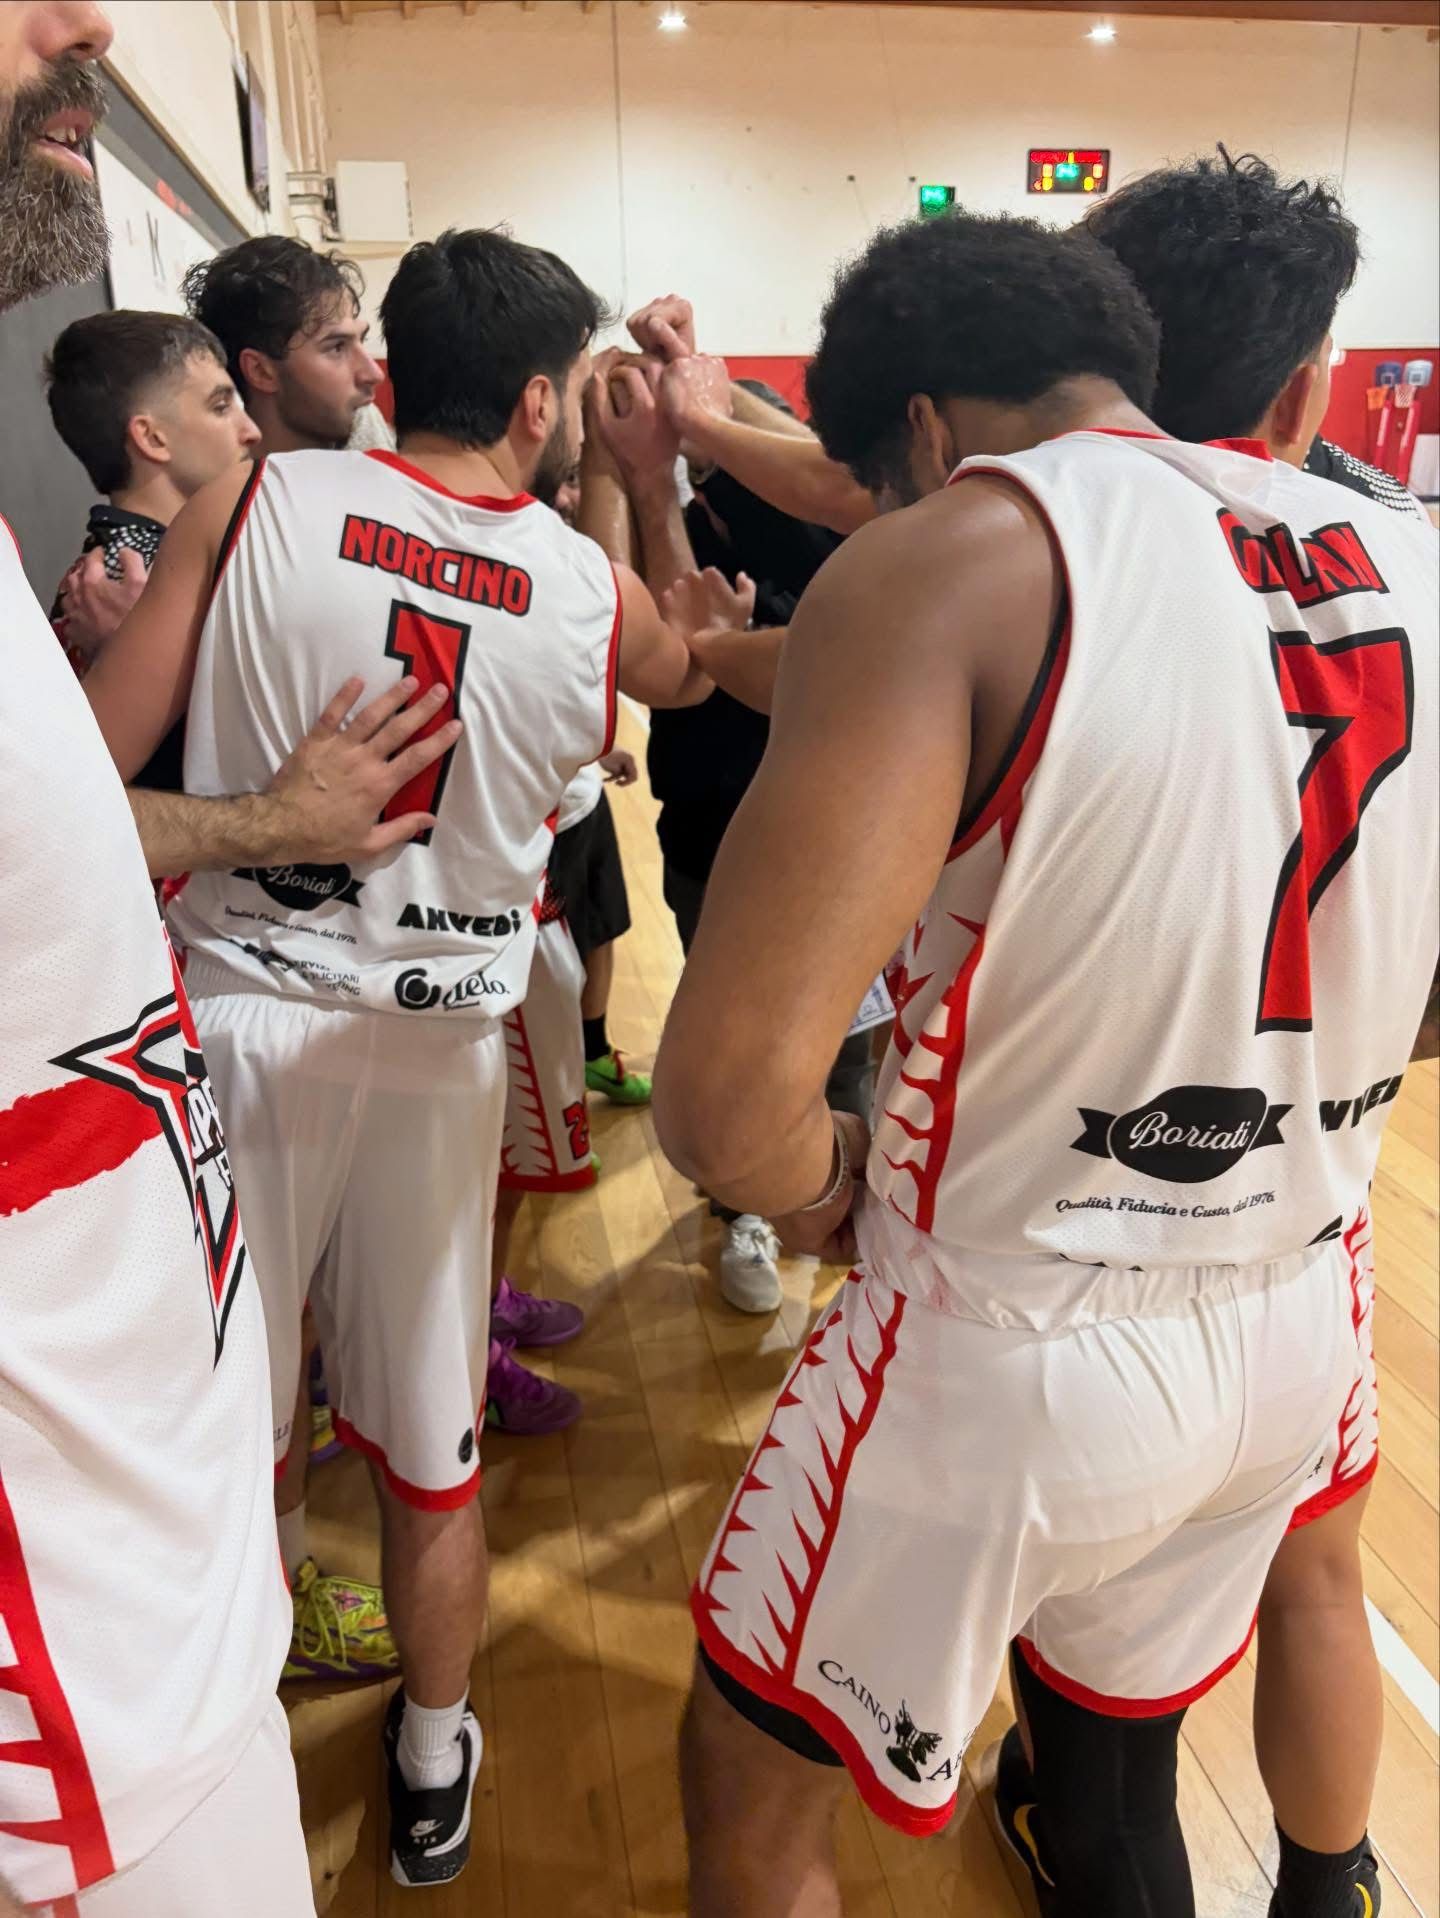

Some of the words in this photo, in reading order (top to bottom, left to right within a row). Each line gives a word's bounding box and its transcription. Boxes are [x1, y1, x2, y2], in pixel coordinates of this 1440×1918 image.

[339, 514, 532, 617] NORCINO
[378, 598, 472, 847] 1
[1254, 626, 1415, 1036] 7
[1129, 1111, 1252, 1151] Boriati
[1056, 1196, 1114, 1213] Qualità,
[1116, 1196, 1177, 1217] Fiducia
[1179, 1207, 1188, 1218] e
[1233, 1196, 1249, 1213] dal
